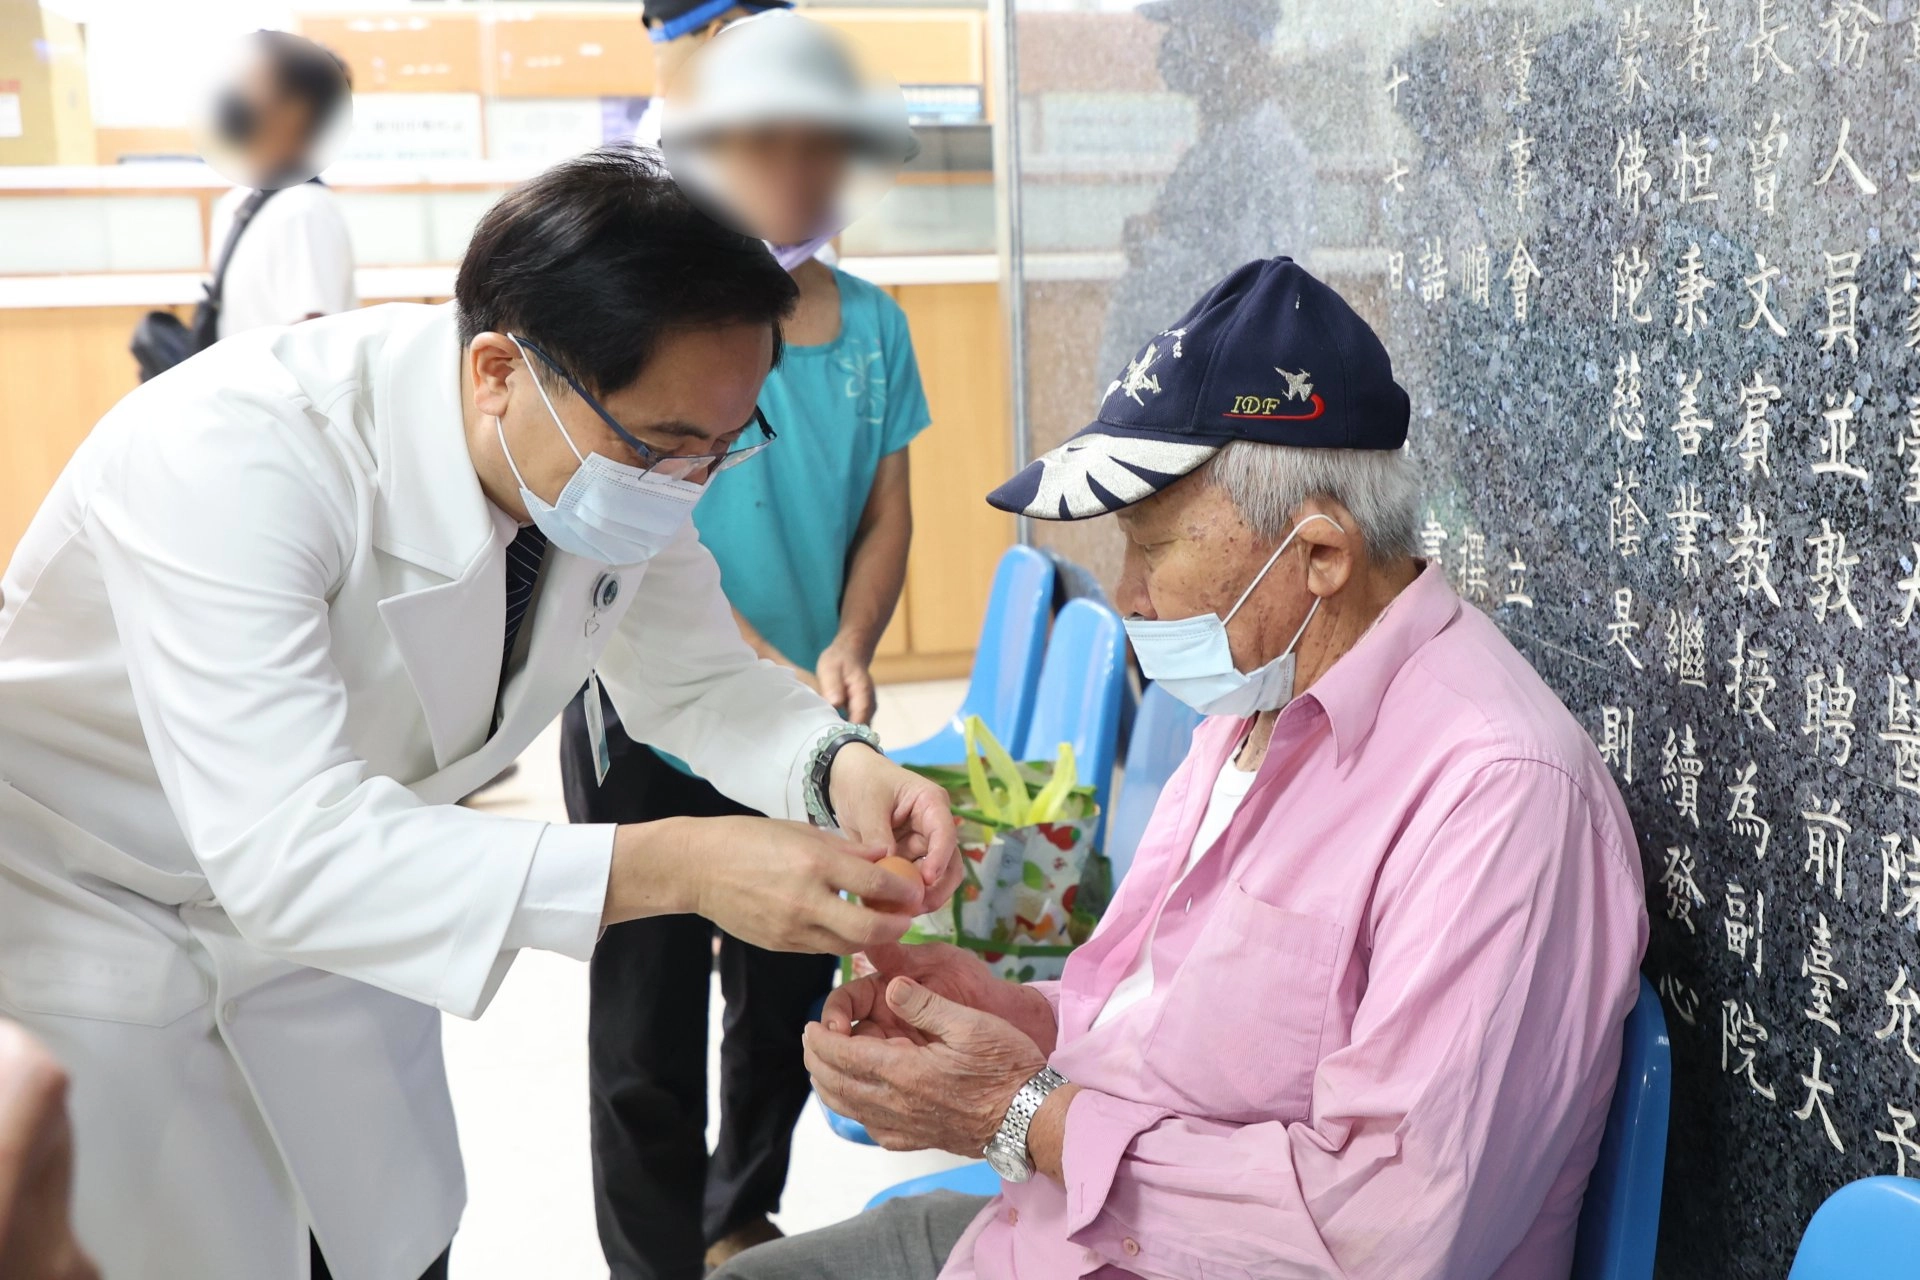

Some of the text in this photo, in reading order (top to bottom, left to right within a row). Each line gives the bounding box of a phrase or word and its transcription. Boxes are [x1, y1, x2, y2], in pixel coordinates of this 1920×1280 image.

[1384, 63, 1409, 291] 十七日
[1503, 15, 1541, 323] 董事會
[1231, 395, 1280, 415] IDF
